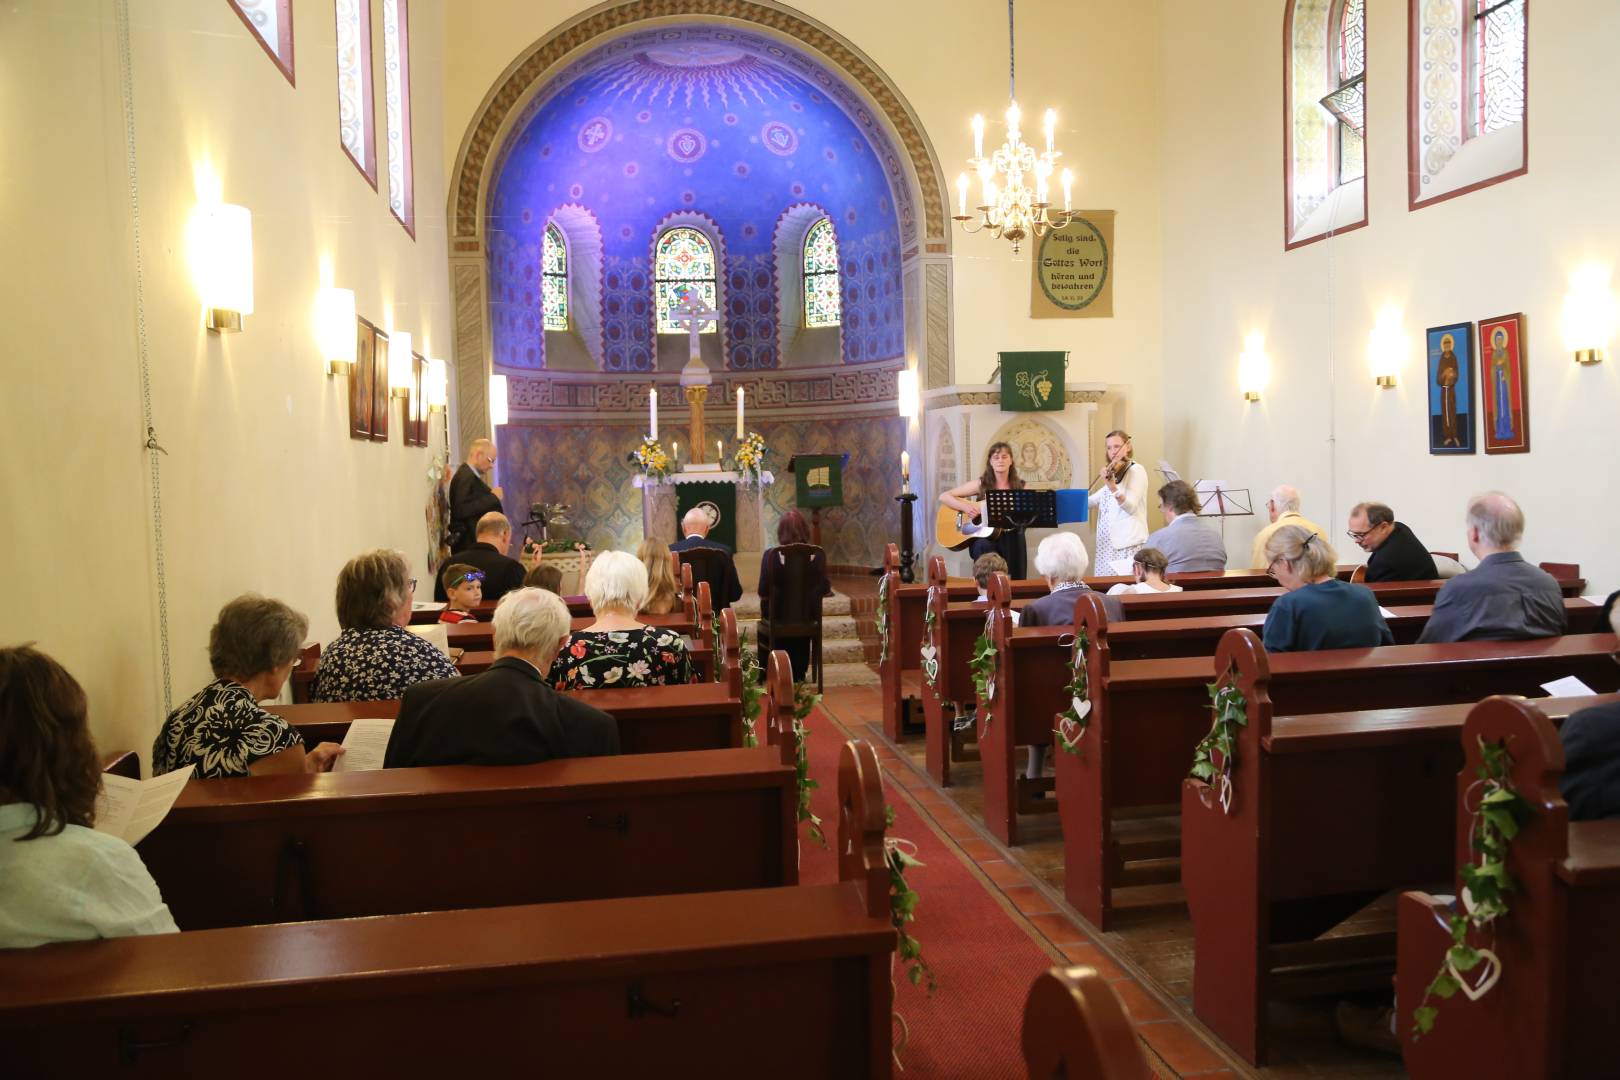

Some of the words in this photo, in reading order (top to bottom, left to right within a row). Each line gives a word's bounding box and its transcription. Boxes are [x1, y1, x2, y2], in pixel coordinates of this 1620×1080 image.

[1053, 233, 1073, 243] Selig
[1066, 247, 1080, 255] die
[1043, 258, 1075, 268] Gottes
[1079, 258, 1103, 268] Wort
[1051, 272, 1075, 280] hören
[1078, 272, 1095, 280] und
[1051, 282, 1094, 290] bewahren
